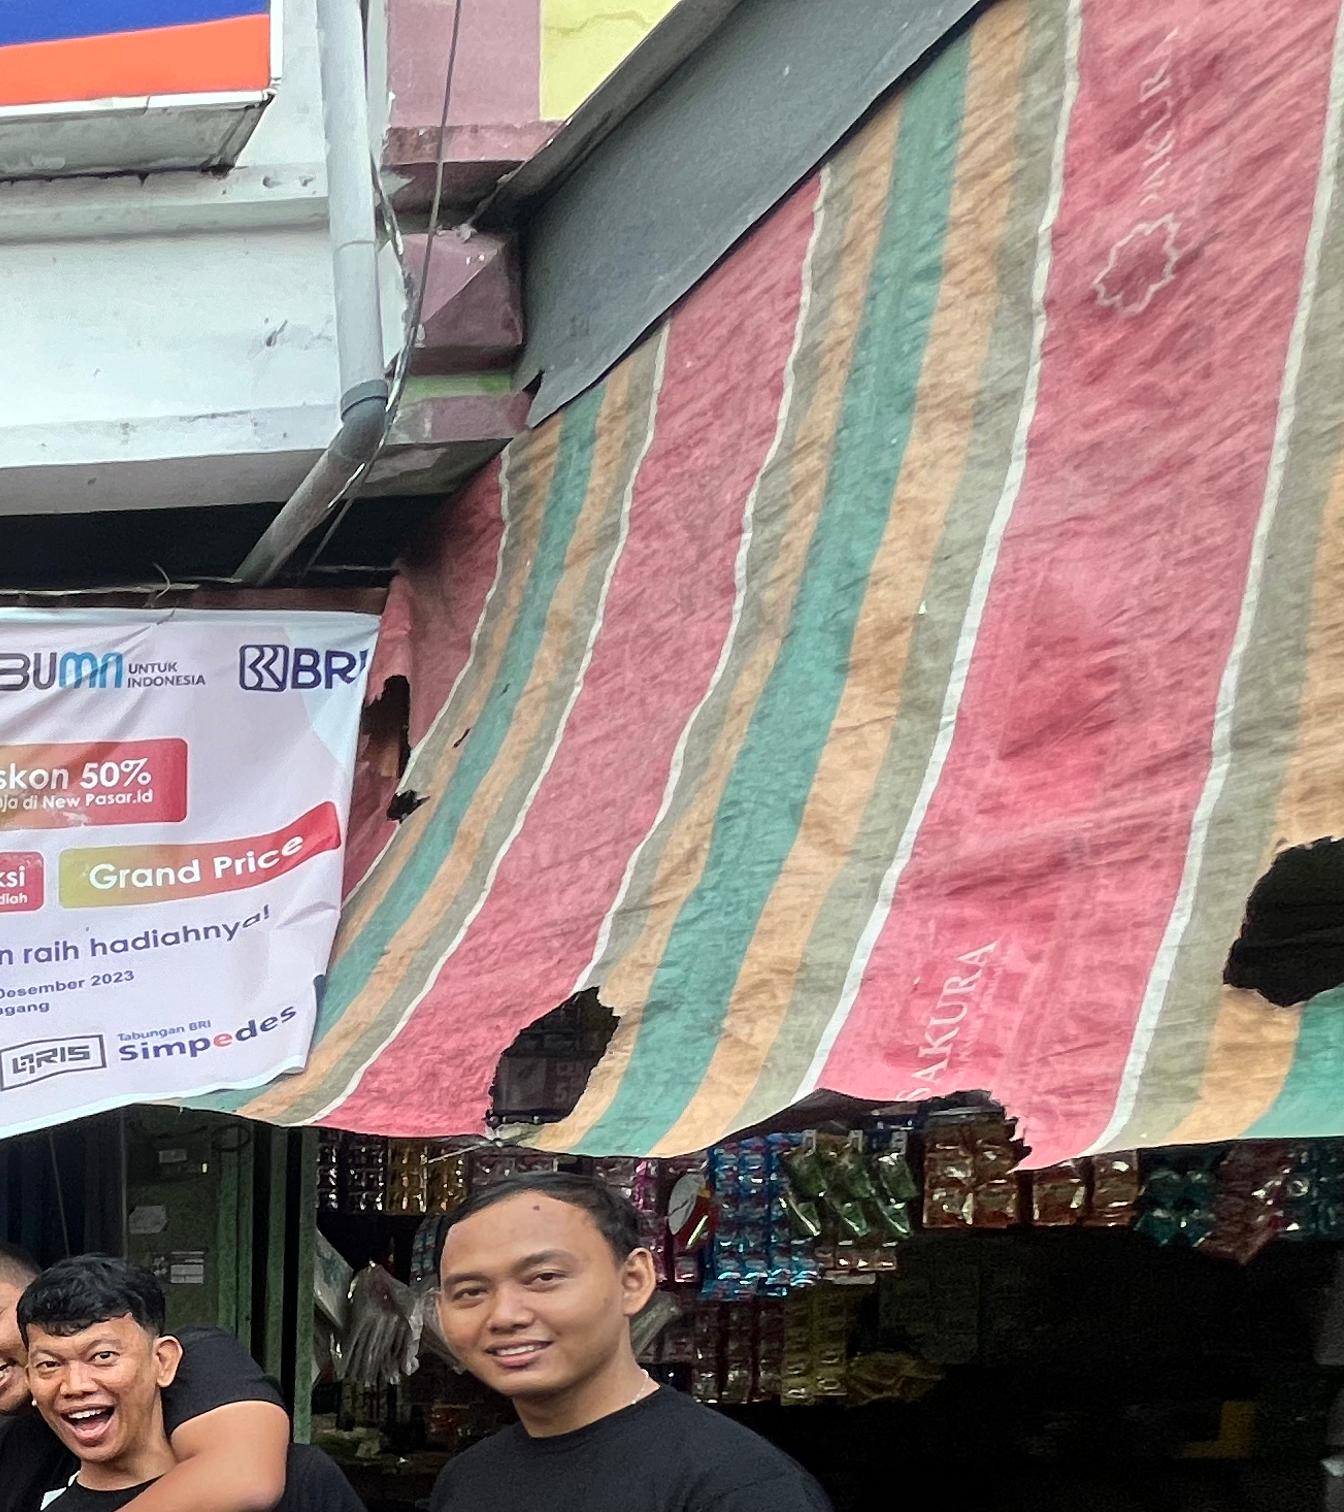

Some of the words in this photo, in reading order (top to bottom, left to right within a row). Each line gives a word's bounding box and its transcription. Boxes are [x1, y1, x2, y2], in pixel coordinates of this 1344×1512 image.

[127, 661, 178, 675] UNTUK
[127, 674, 207, 690] INDONESIA
[79, 758, 154, 790] 50%
[22, 795, 38, 811] di
[42, 794, 80, 811] New
[85, 788, 154, 807] Pasar.id
[88, 858, 202, 891] Grand
[212, 833, 306, 880] Price
[23, 937, 81, 966] raih
[89, 903, 273, 960] hadiahnya!
[90, 968, 136, 989] 2023
[117, 1023, 186, 1043] Tabungan
[188, 1019, 212, 1032] BRI
[117, 1003, 298, 1062] Simpedes
[11, 1044, 91, 1076] QRIS
